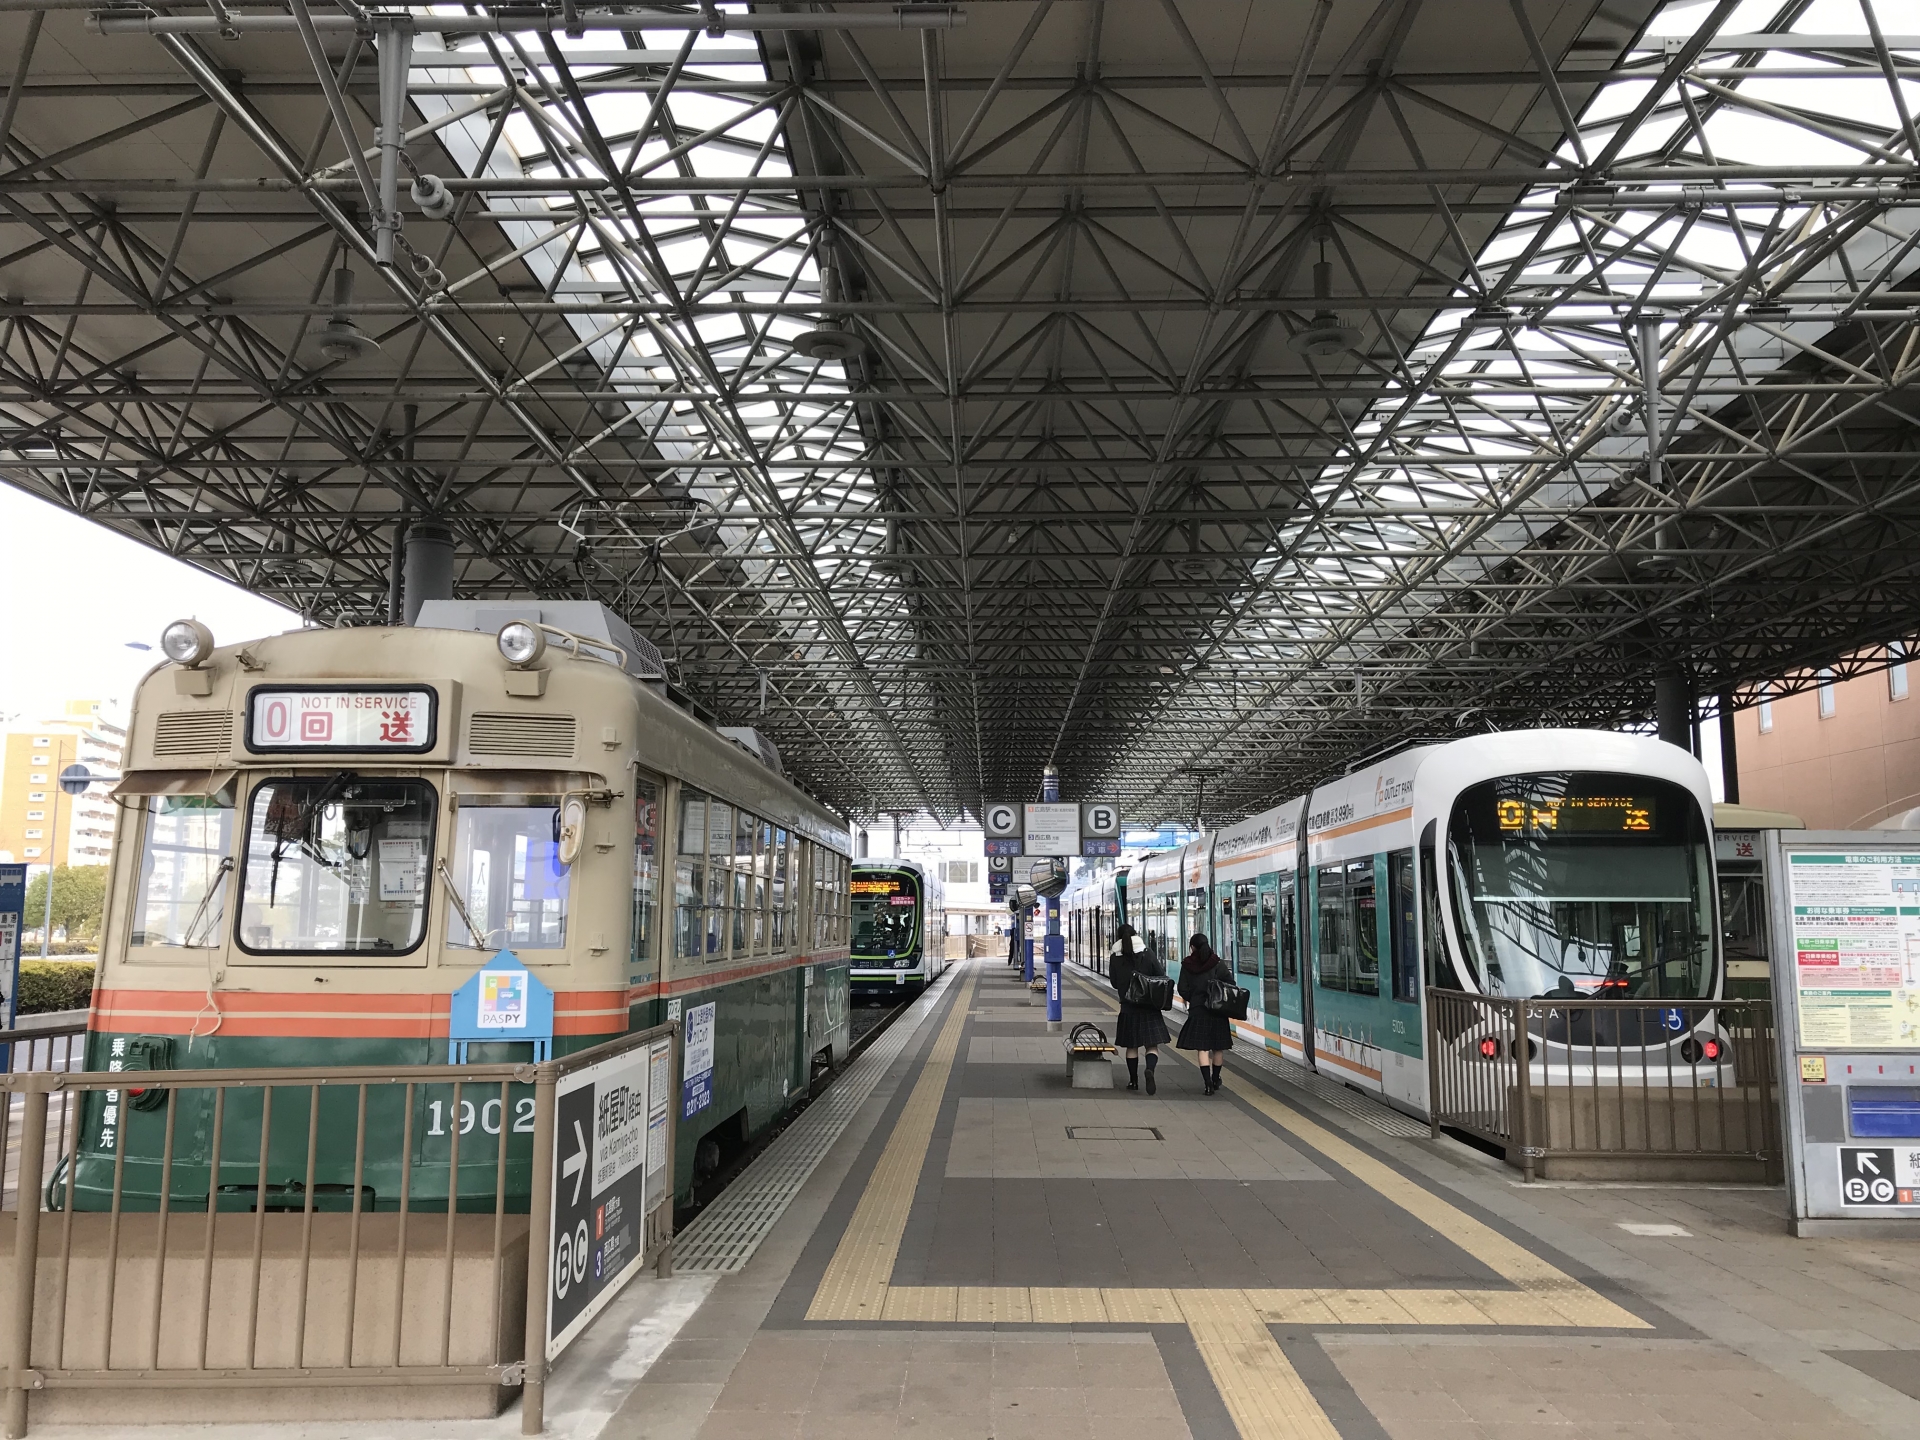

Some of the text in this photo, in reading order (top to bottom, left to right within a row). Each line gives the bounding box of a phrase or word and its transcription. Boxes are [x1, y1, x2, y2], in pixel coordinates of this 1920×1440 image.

[301, 697, 417, 709] NOT IN SERVICE
[266, 701, 287, 738] 0
[300, 711, 415, 742] 回 送
[1384, 784, 1401, 800] OUTLET
[1547, 798, 1634, 807] NOT IN SERVICE
[992, 809, 1011, 830] C
[1094, 810, 1112, 830] B
[1717, 834, 1757, 842] ERVICE
[1735, 842, 1755, 857] 送
[1845, 856, 1902, 864] 電車のご利用方法
[1807, 907, 1850, 915] お得な乗車券
[483, 1014, 520, 1024] PASPY
[427, 1098, 536, 1136] 1902
[609, 1126, 639, 1158] Kamiya-cho
[1850, 1181, 1890, 1199] B C
